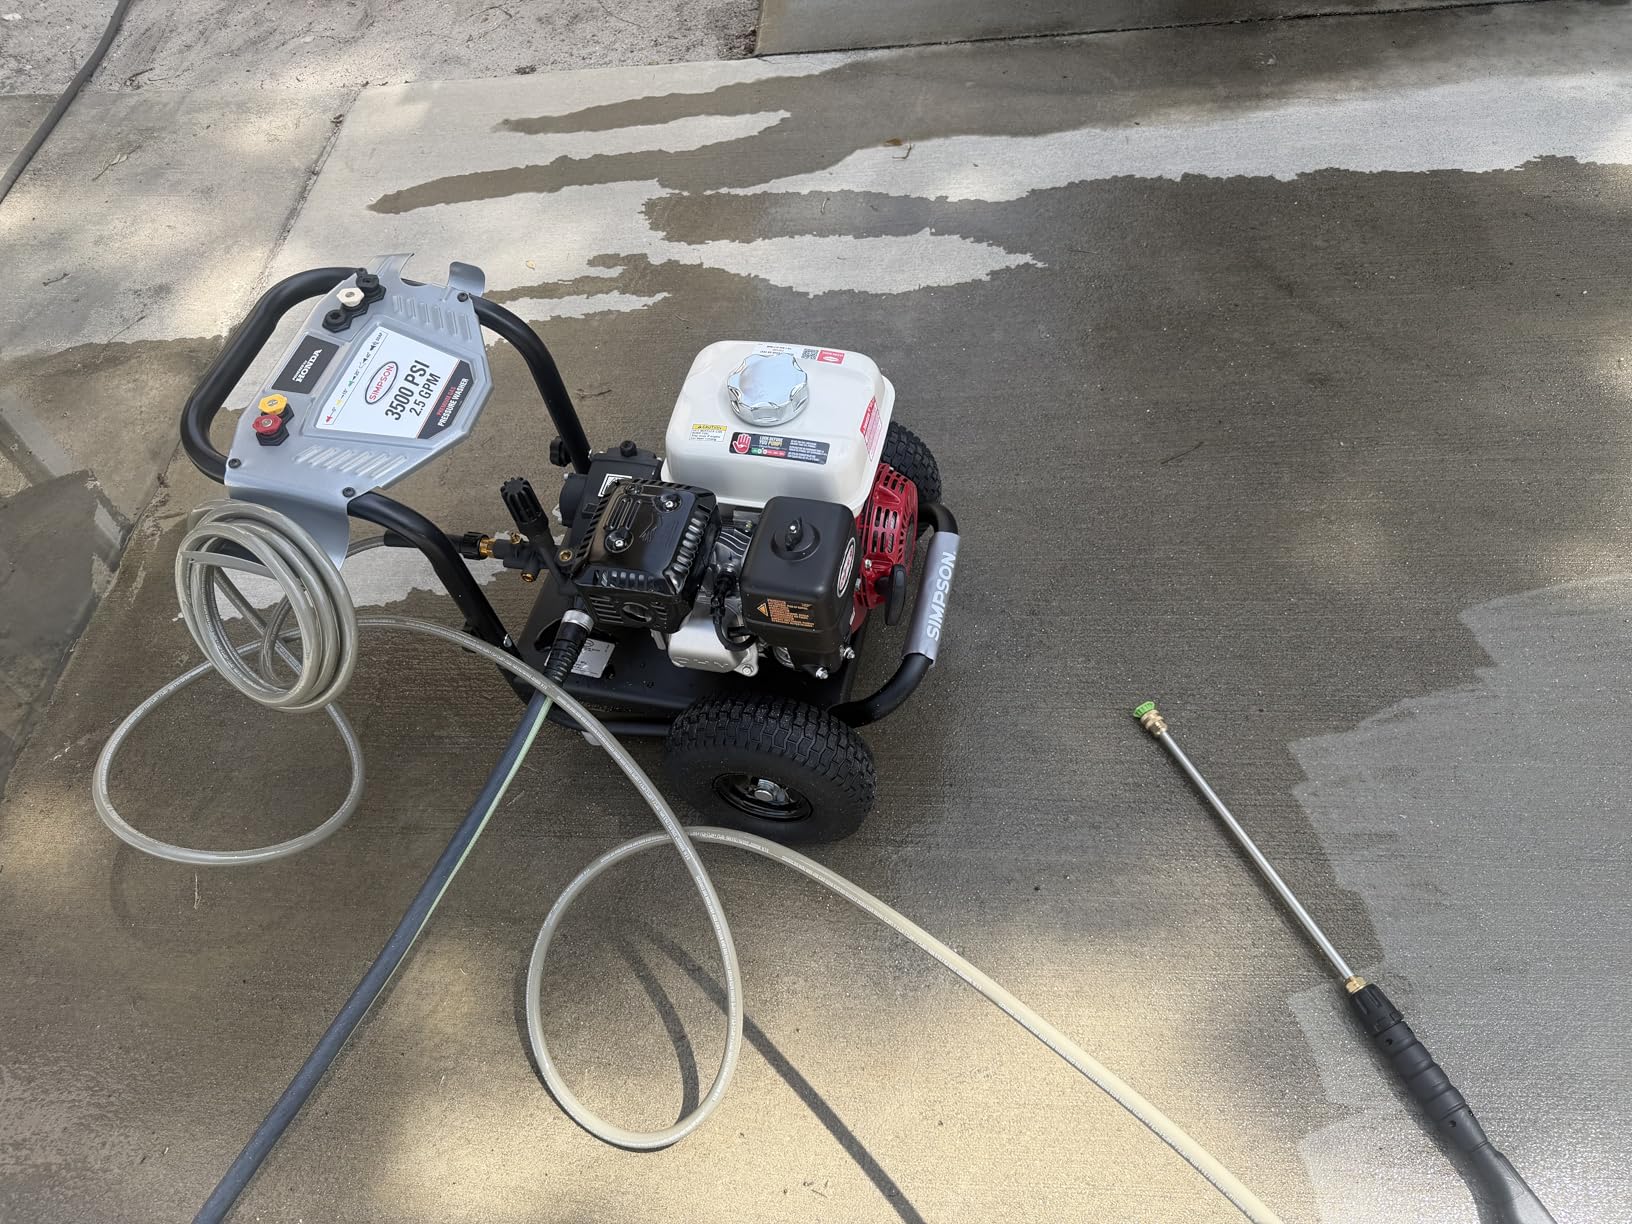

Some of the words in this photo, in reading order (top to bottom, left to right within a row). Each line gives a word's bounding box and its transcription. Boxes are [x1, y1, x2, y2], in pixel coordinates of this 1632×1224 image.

[295, 349, 323, 383] HONDA
[369, 365, 395, 400] SIMPSON
[384, 386, 415, 421] 3500
[404, 359, 430, 387] PSI
[409, 398, 427, 416] 2.5
[418, 372, 441, 399] GPM
[437, 400, 458, 427] PRESSURE
[451, 378, 469, 400] WASHER
[926, 551, 956, 642] SIMPSON
